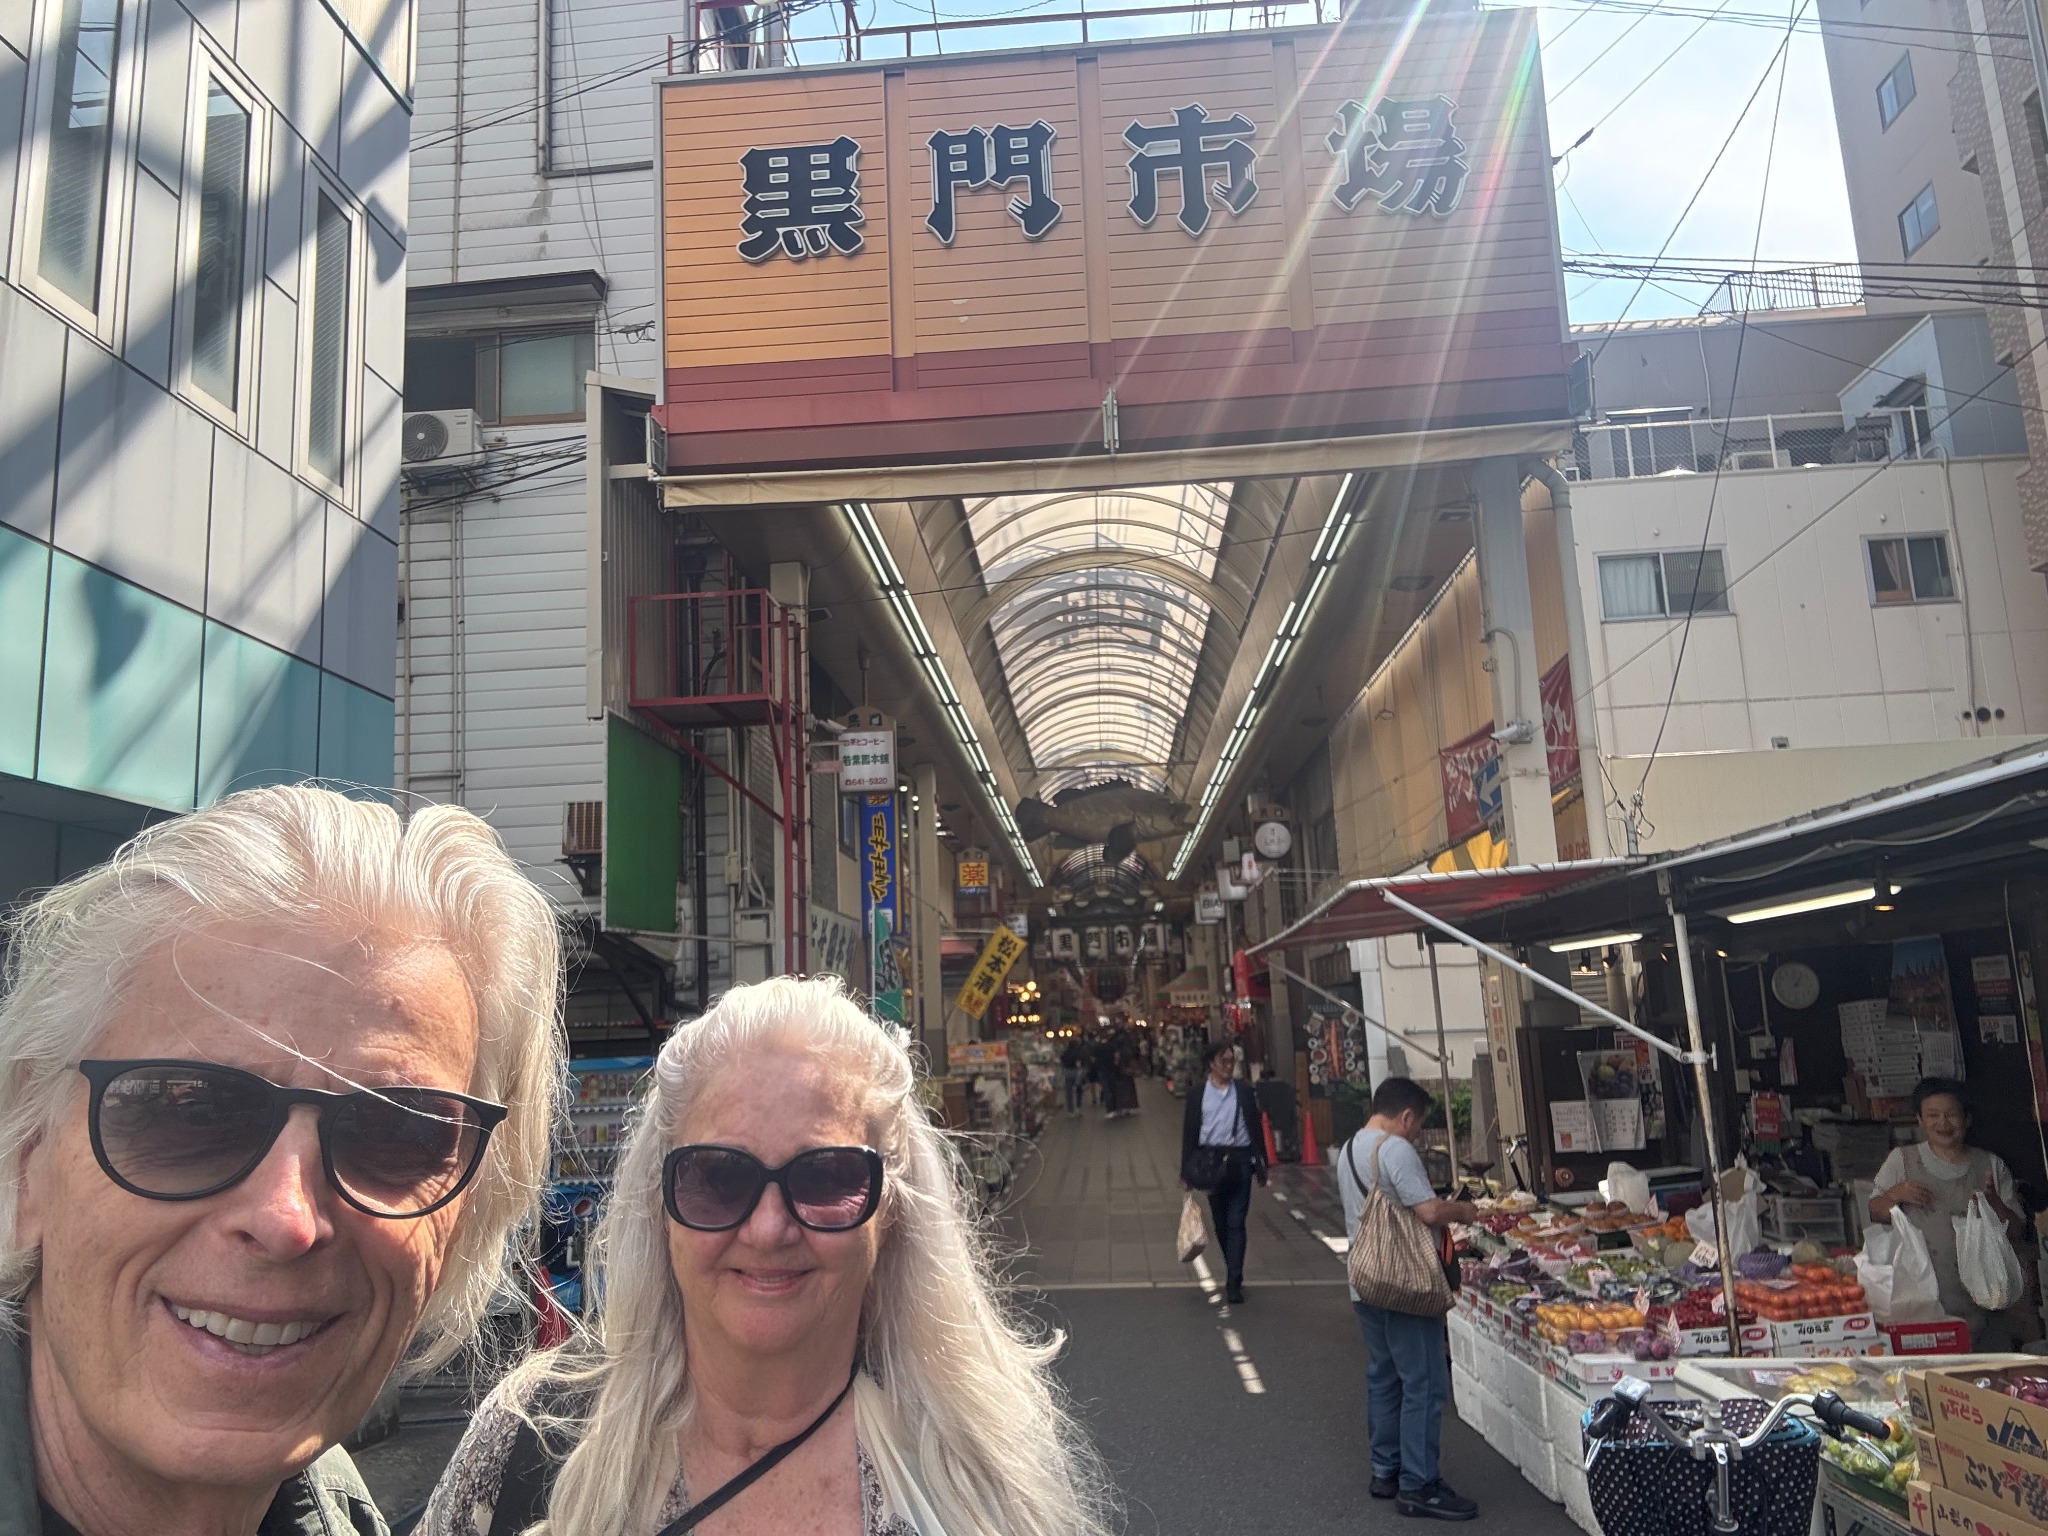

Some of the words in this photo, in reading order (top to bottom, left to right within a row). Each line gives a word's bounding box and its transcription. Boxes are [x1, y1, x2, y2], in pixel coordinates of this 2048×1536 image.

[737, 94, 1469, 262] 黒門市場
[869, 812, 891, 903] マツモトキヨシ
[962, 863, 986, 886] 薬
[974, 935, 1018, 995] 松本清
[1945, 1398, 1984, 1425] ぶどう
